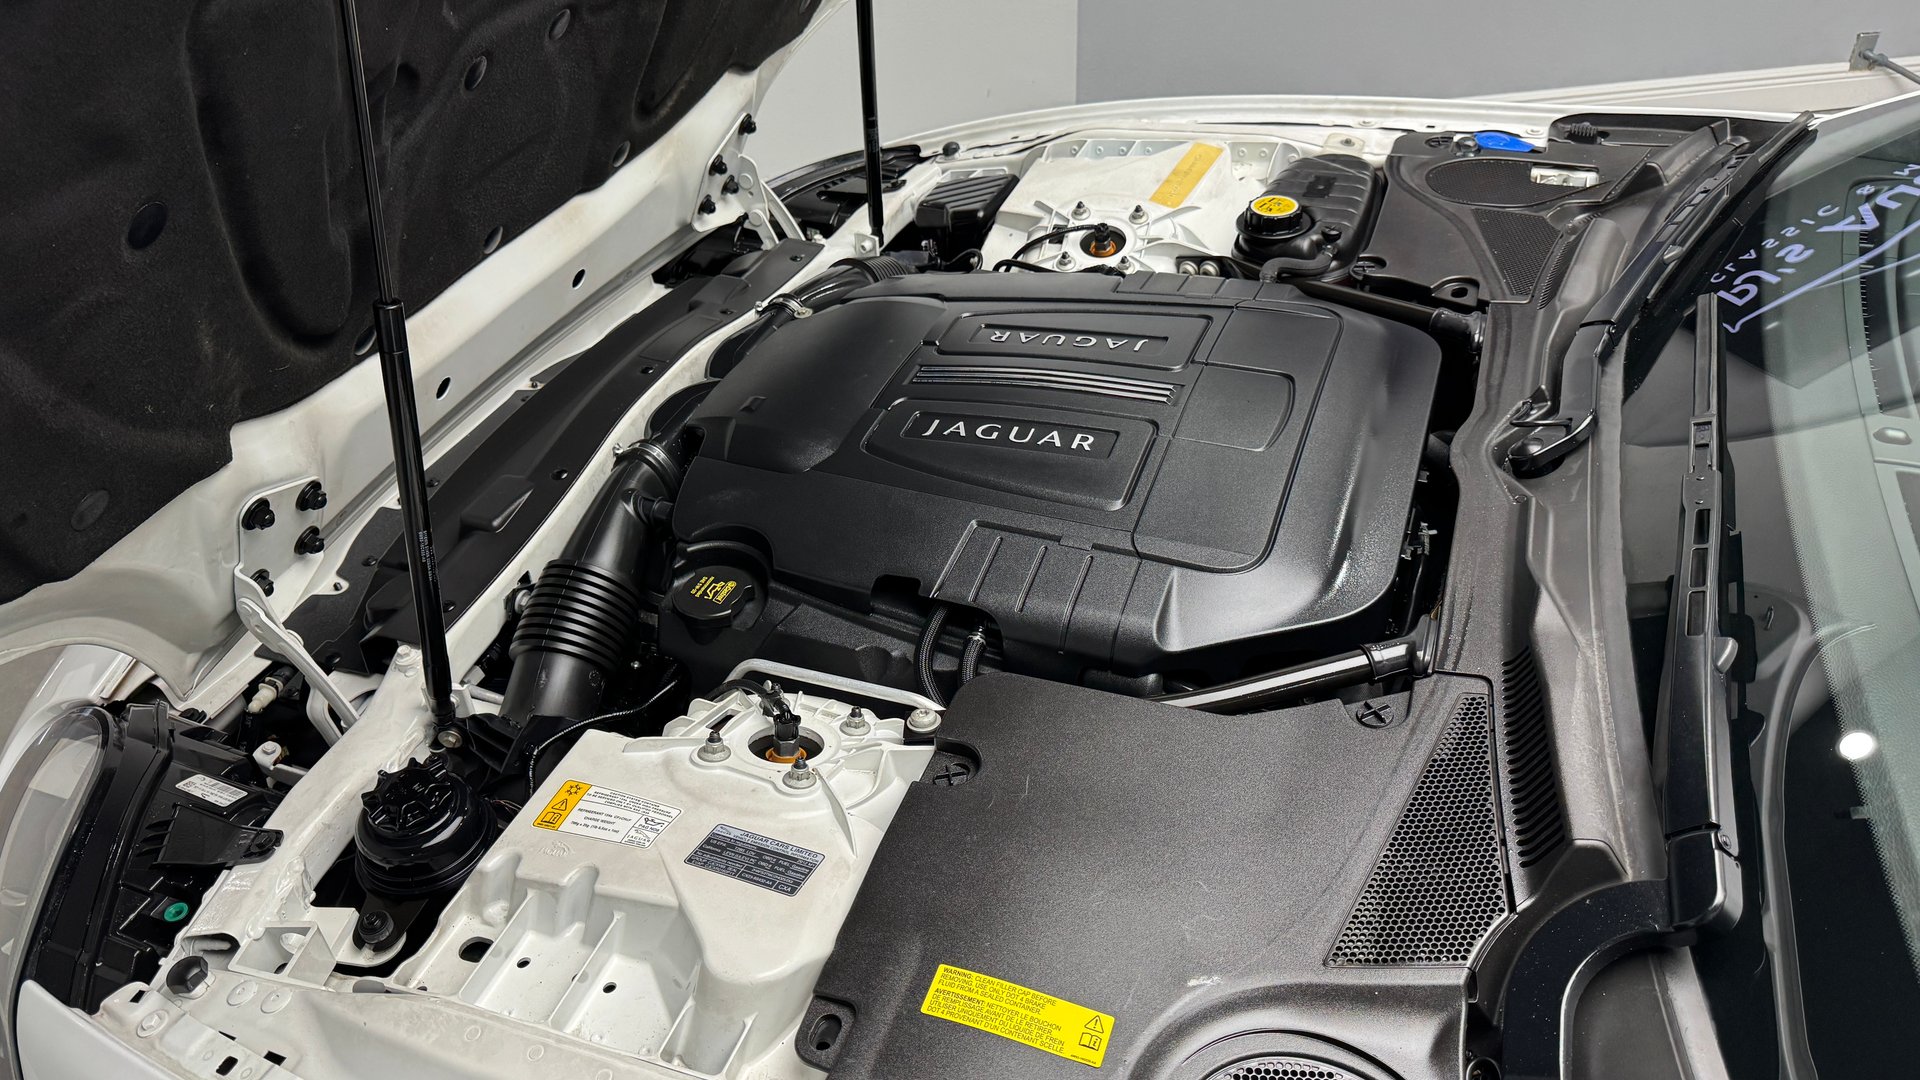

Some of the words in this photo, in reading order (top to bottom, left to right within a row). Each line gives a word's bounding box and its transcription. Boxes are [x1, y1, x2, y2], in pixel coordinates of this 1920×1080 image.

[990, 330, 1149, 352] JAGUAR
[921, 418, 1095, 452] JAGUAR
[626, 834, 651, 842] JAGUAR
[739, 831, 769, 843] JAGUAR
[768, 840, 790, 849] CARS
[789, 846, 818, 858] LIMITED
[937, 978, 955, 988] FLUID
[955, 983, 974, 994] FROM
[979, 990, 1004, 1002] SEALED
[1003, 998, 1042, 1015] CONTAINER.
[942, 966, 973, 980] WARNING:
[974, 975, 995, 986] CLEAN
[995, 981, 1017, 992] FILLER
[1017, 988, 1031, 997] CAP
[1030, 993, 1057, 1006] BEFORE
[974, 982, 988, 990] USE
[988, 986, 1005, 996] ONLY
[1005, 991, 1019, 1000] DOT
[1024, 997, 1046, 1009] BRAKE
[926, 1004, 940, 1014] DOT
[945, 1009, 982, 1026] PROVENANT
[983, 1021, 999, 1031] D'UN
[999, 1026, 1039, 1044] CONTENANT
[928, 998, 956, 1012] UTILISER
[956, 1006, 998, 1023] UNIQUEMENT
[998, 1019, 1008, 1027] DU
[1008, 1022, 1035, 1036] LIQUIDE
[1034, 1031, 1044, 1039] DE
[1044, 1035, 1064, 1046] FREIN
[931, 992, 941, 1000] DE
[941, 995, 984, 1013] REMPLISSAGE
[984, 1008, 1005, 1019] AVANT
[1005, 1014, 1014, 1022] DE
[934, 986, 986, 1007] AVERTISSEMENT:
[986, 1001, 1019, 1016] NETTOYER
[1019, 1012, 1029, 1020] LE
[1028, 1015, 1062, 1031] BOUCHON
